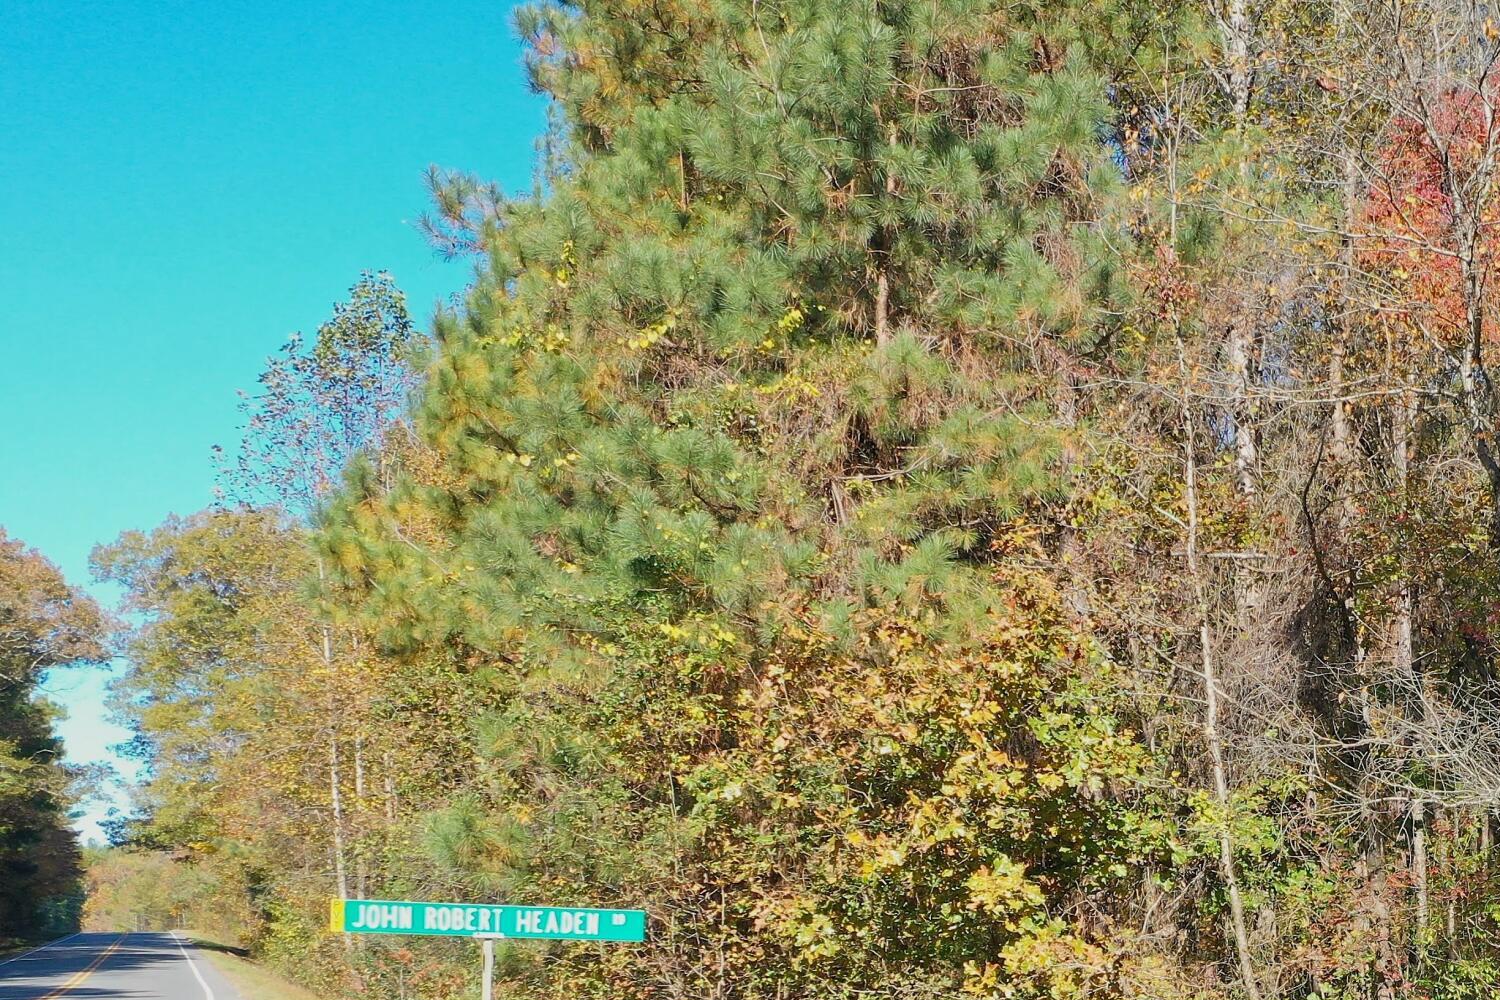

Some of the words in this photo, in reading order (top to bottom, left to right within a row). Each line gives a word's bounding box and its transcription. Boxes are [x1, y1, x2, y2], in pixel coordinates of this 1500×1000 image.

[352, 904, 412, 929] JOHN
[424, 905, 503, 932] ROBERT
[516, 910, 599, 935] HEADEN
